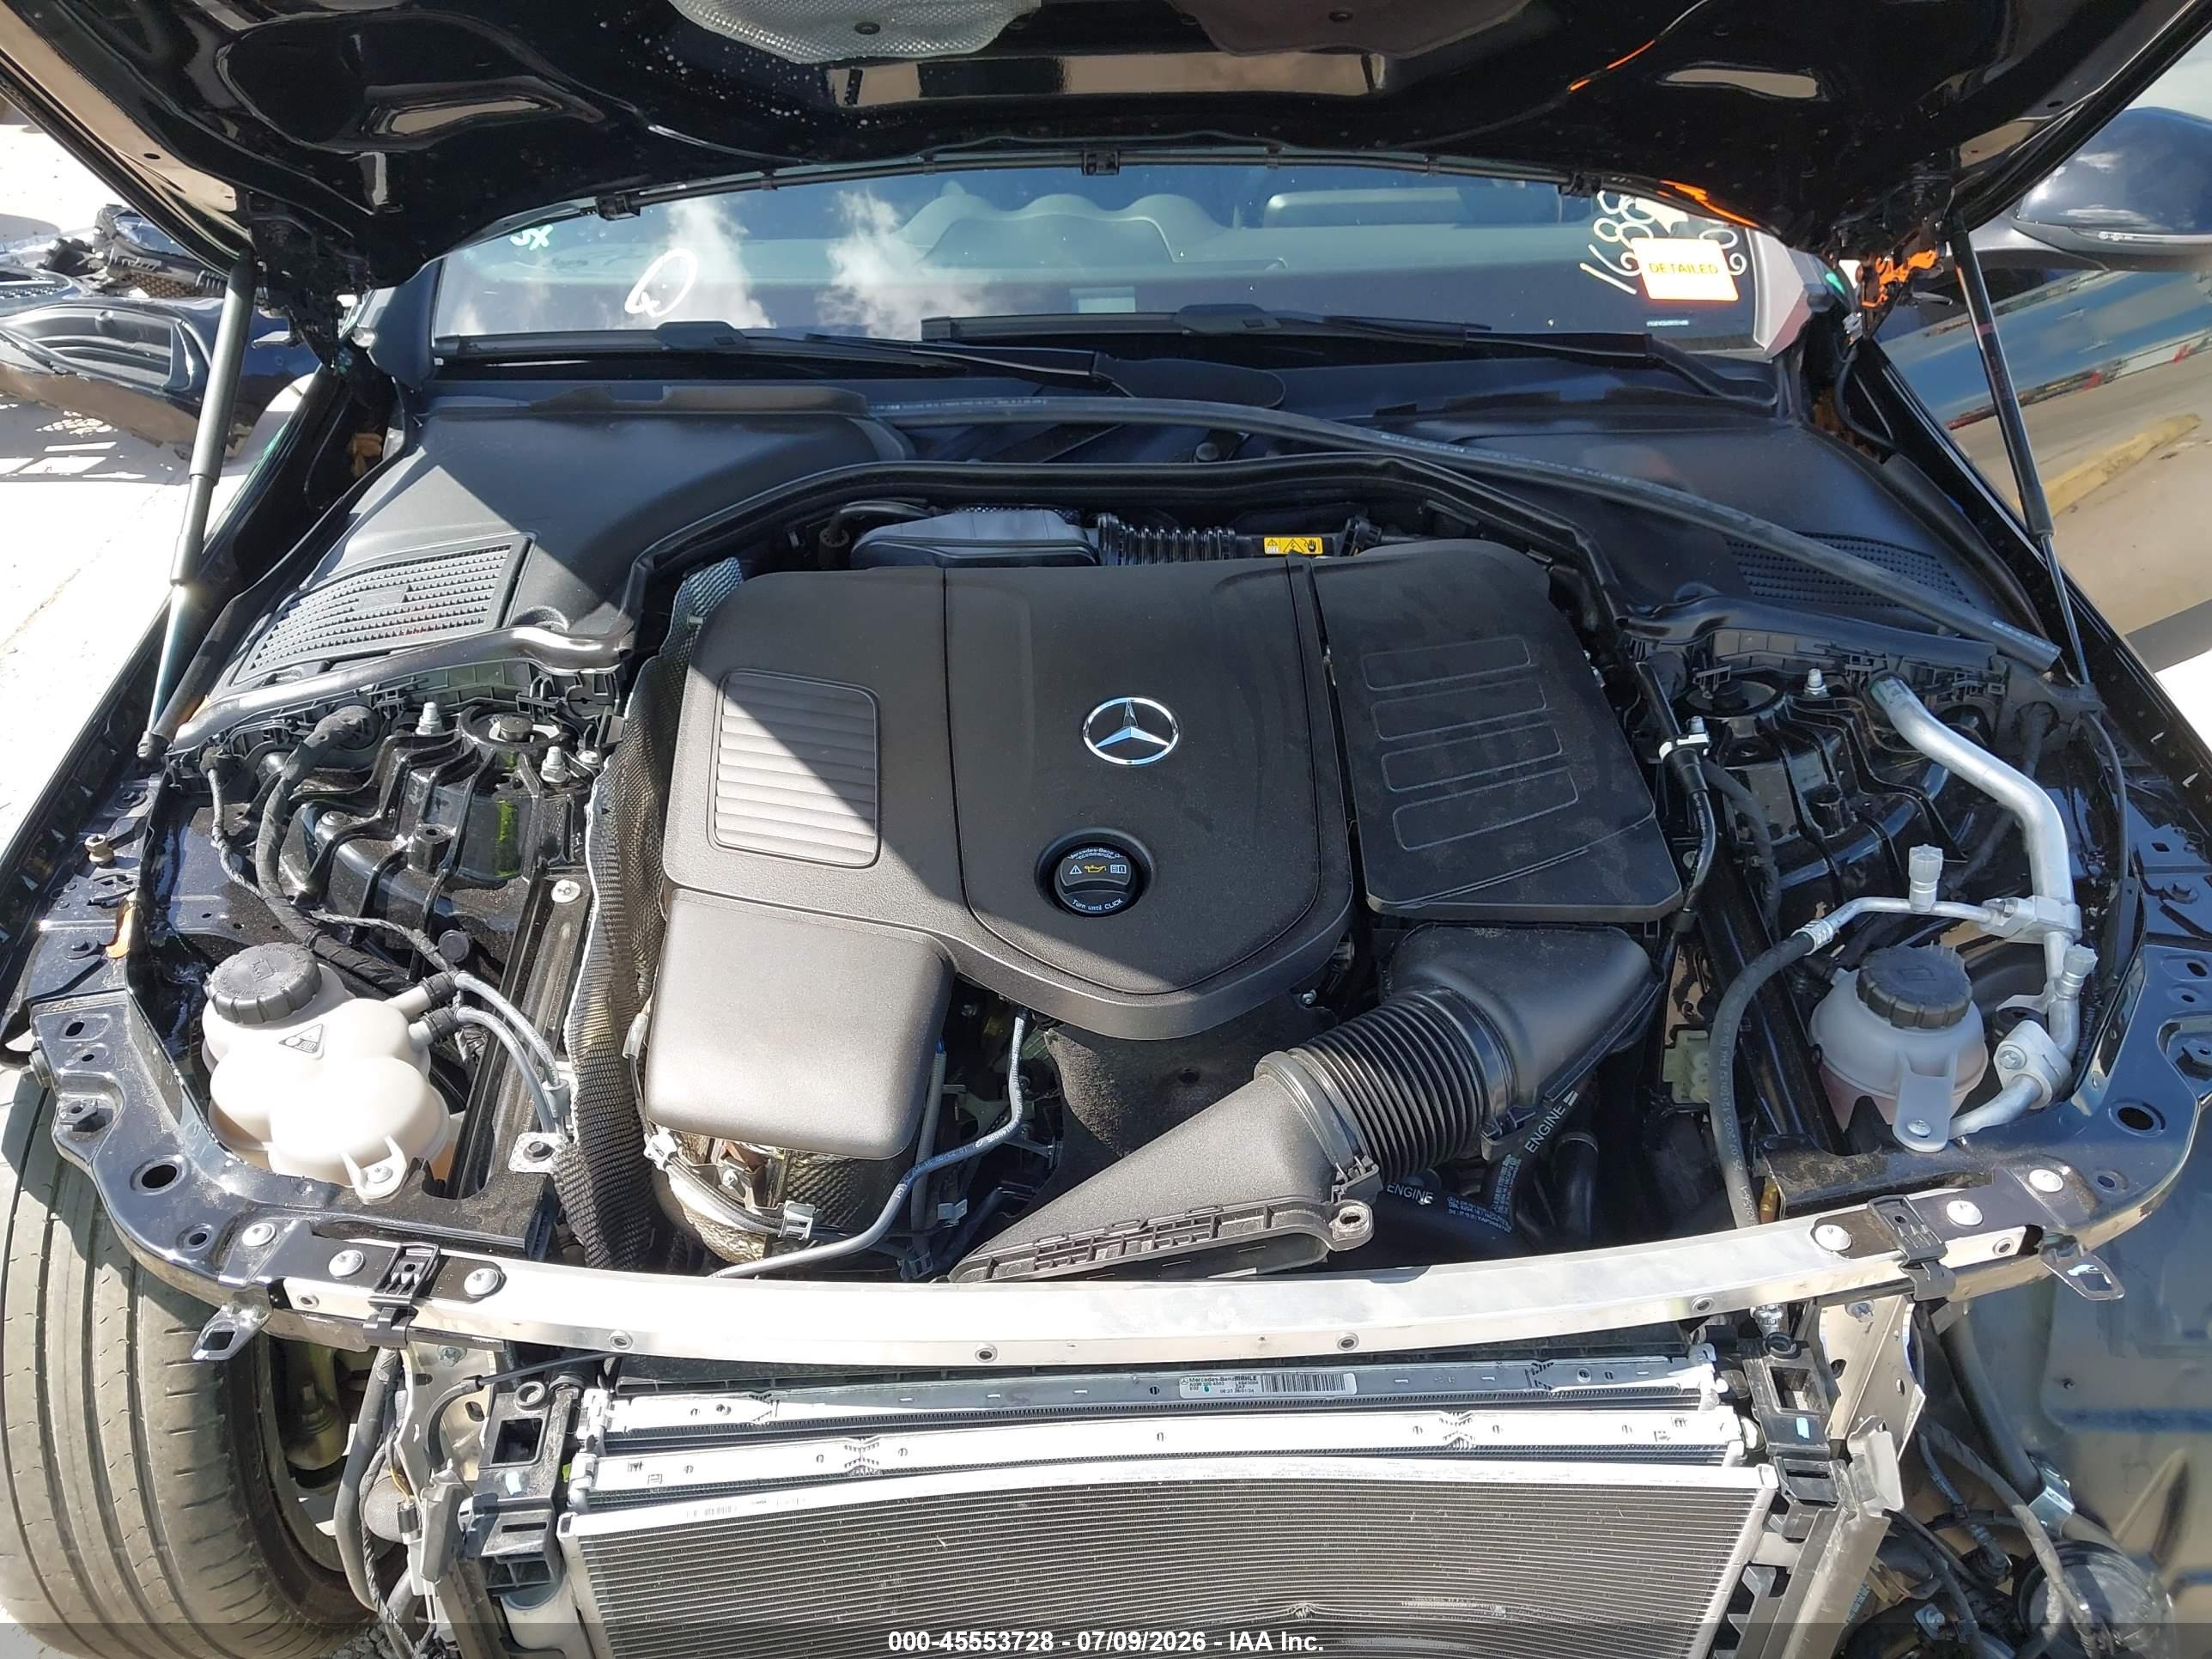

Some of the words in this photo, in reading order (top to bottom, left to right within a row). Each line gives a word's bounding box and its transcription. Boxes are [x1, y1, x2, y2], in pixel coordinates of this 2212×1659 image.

[1649, 263, 1718, 275] DETAILED
[1073, 899, 1086, 908] Turn
[1104, 898, 1124, 909] CLICK
[1524, 1105, 1566, 1153] ENGINE
[1387, 1184, 1434, 1205] ENGINE
